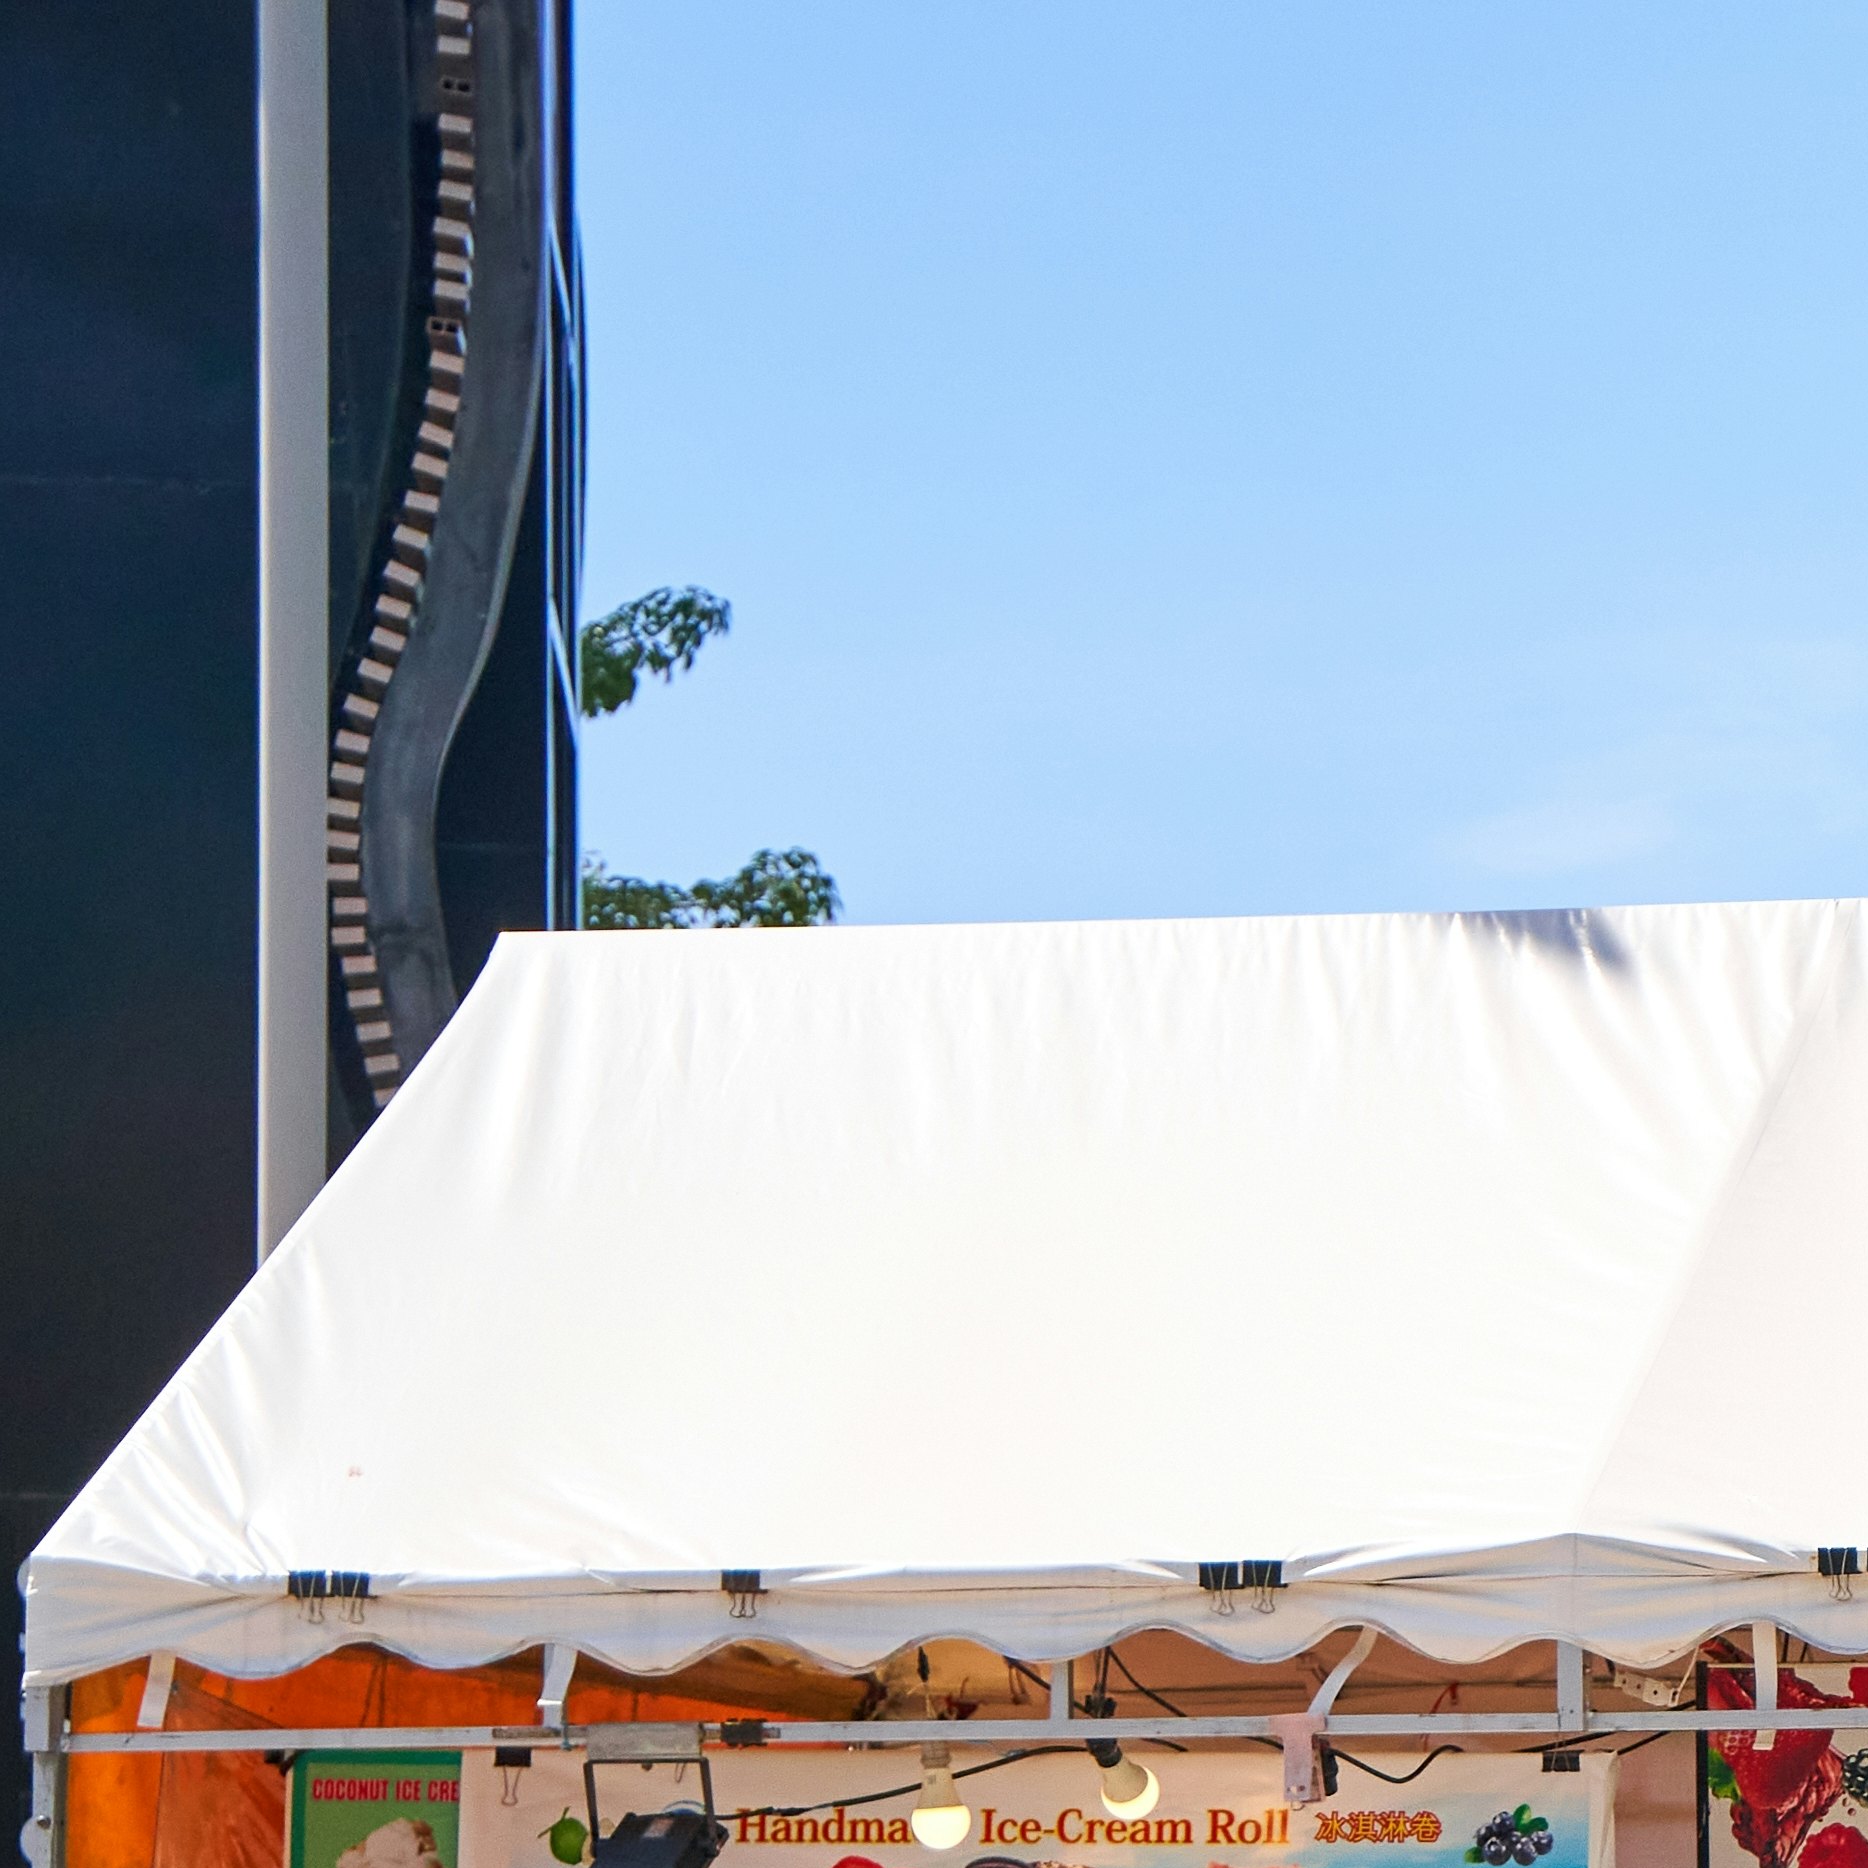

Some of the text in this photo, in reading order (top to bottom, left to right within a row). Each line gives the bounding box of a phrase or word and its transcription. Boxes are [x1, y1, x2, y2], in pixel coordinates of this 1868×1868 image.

[313, 1778, 389, 1802] COCONUT
[396, 1780, 421, 1802] ICE
[980, 1807, 1291, 1845] Ice-Cream Roll
[1316, 1810, 1442, 1844] 冰淇淋卷
